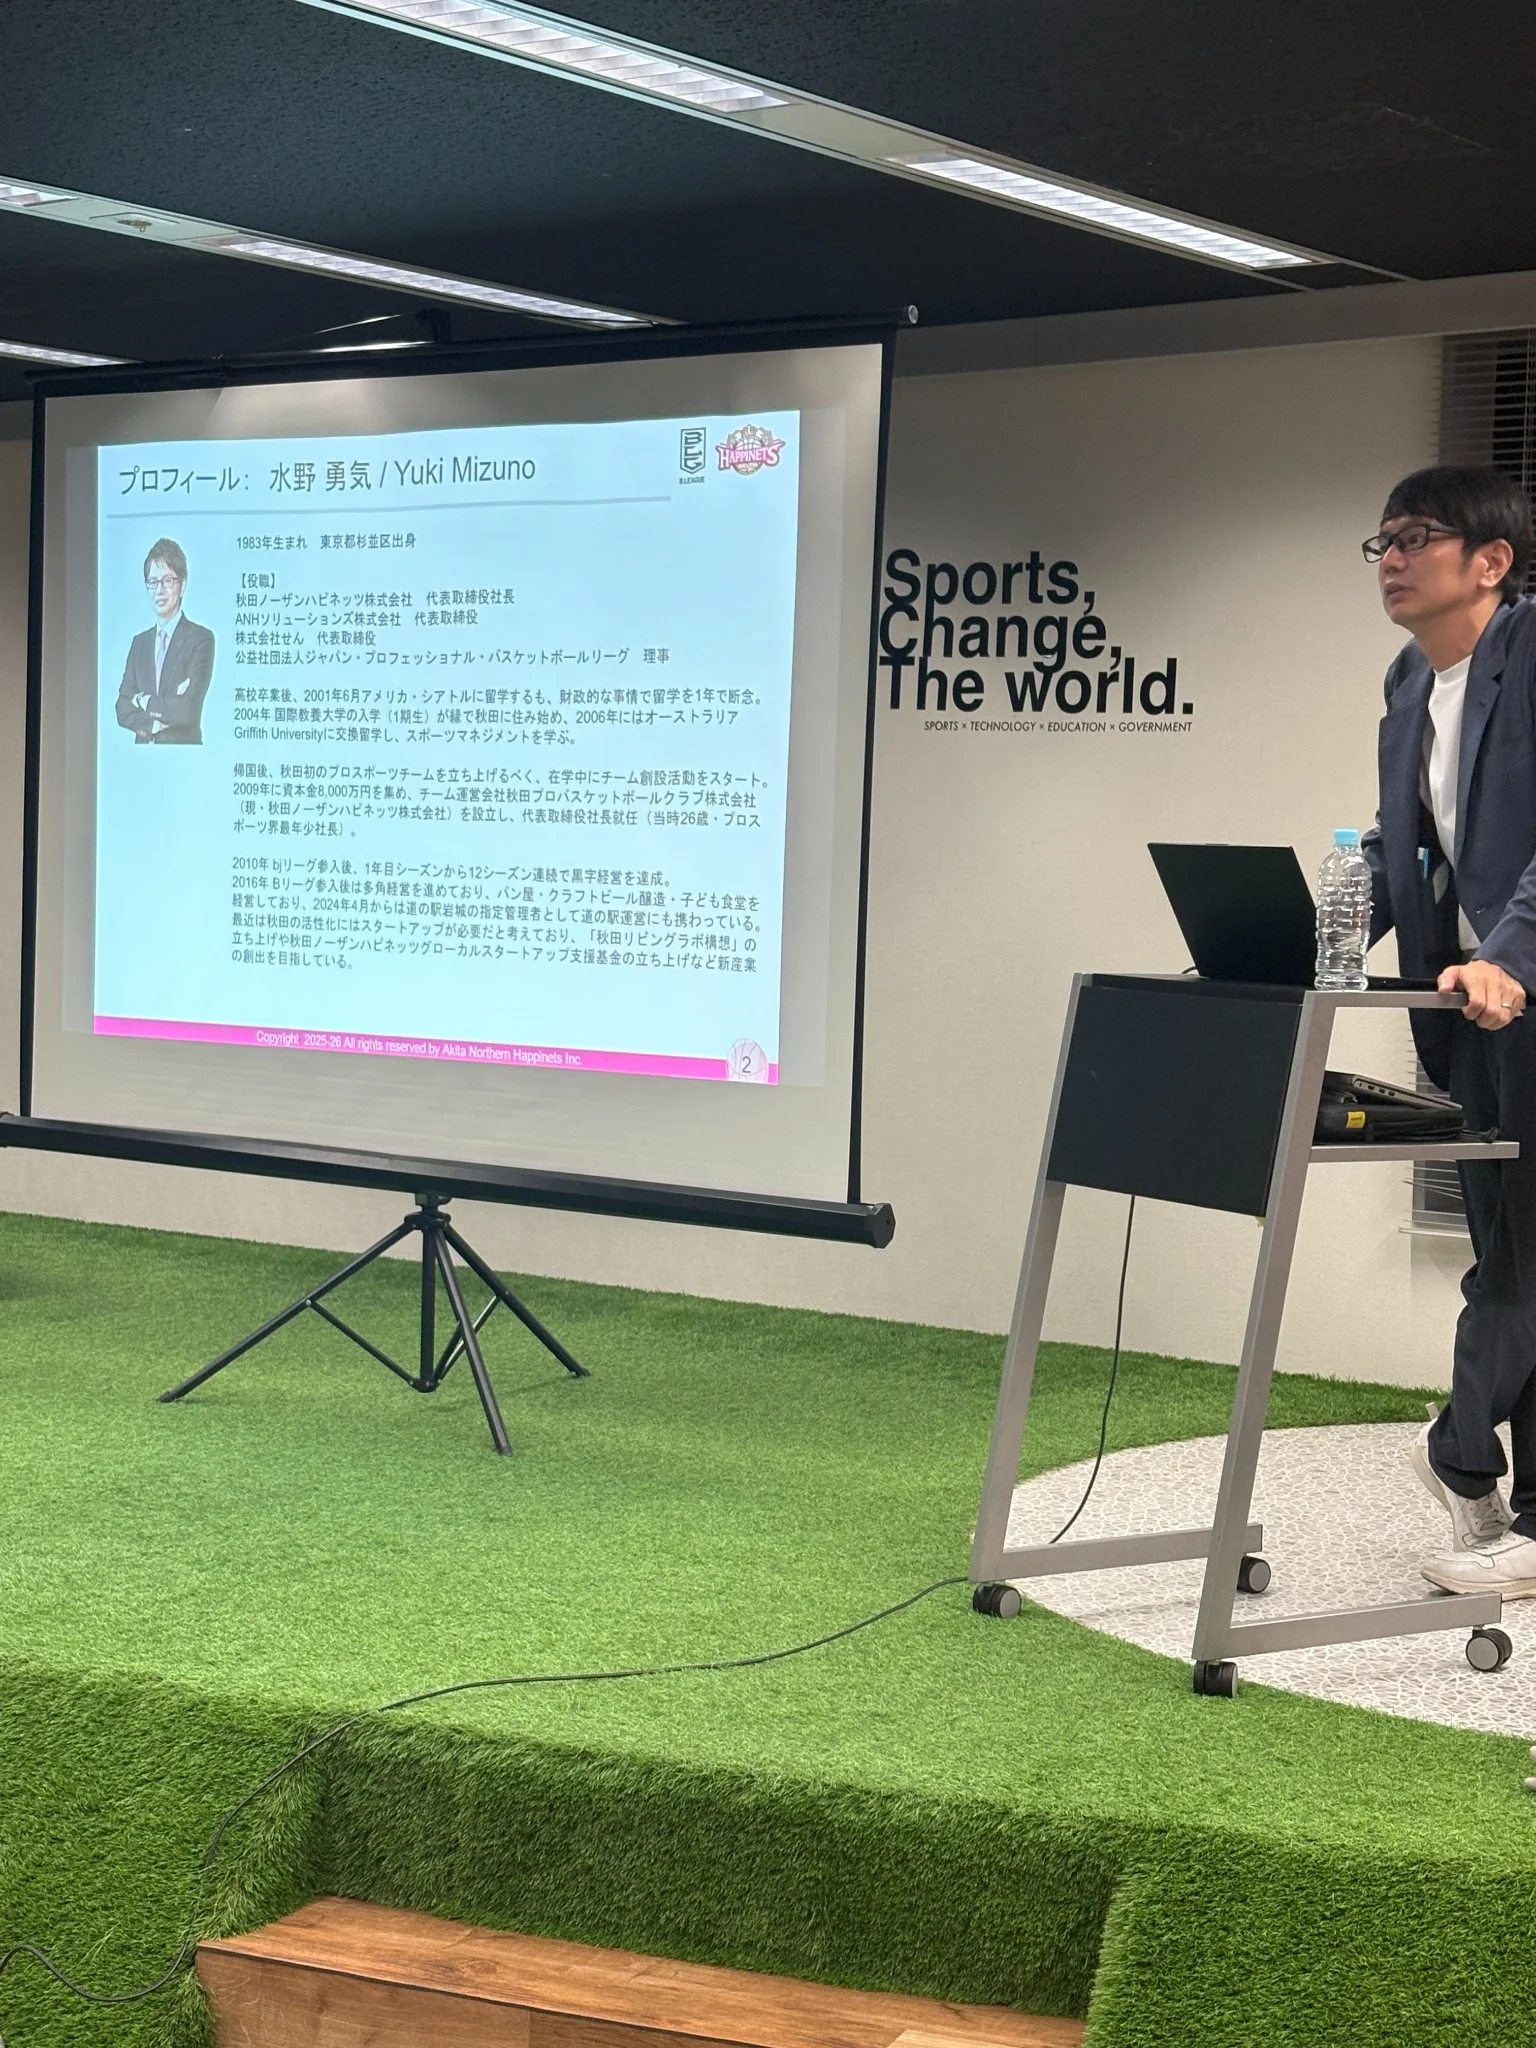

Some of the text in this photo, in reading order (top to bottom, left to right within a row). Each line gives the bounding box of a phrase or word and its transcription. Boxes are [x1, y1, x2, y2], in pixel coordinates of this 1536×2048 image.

[716, 440, 785, 470] HAPPINETS
[270, 461, 316, 493] 水野
[326, 459, 371, 492] 勇気
[379, 461, 387, 488] /
[394, 457, 443, 488] Yuki
[452, 456, 536, 483] Mizuno
[236, 533, 417, 550] 1983年生まれ 東京都杉並区出身
[241, 573, 275, 589] 【役職】
[884, 548, 1095, 615] Sports,
[236, 588, 515, 607] 秋田ノーザンハピネッツ株式会社 代表取締役社長
[235, 609, 478, 626] ANHソリューションズ株式会社 代表取締役
[235, 630, 376, 646] 株式会社せん 代表取締役
[879, 602, 1122, 673] Change,
[643, 648, 671, 664] 理事
[879, 655, 1194, 715] The world.
[234, 726, 268, 740] Griffith
[924, 721, 959, 732] SPORTS
[970, 721, 1036, 733] TECHNOLOGY
[1047, 721, 1107, 733] EDUCATION
[1118, 721, 1193, 733] GOVERNMENT
[232, 949, 352, 970] の創出を目指している。
[256, 1030, 299, 1047] Copyright
[344, 1036, 356, 1049] All
[358, 1037, 383, 1052] rights
[386, 1039, 426, 1054] reserved
[428, 1043, 440, 1057] by
[469, 1046, 510, 1060] Northern
[513, 1049, 563, 1065] Happinets
[565, 1052, 583, 1066] Inc.
[741, 1055, 752, 1074] 2
